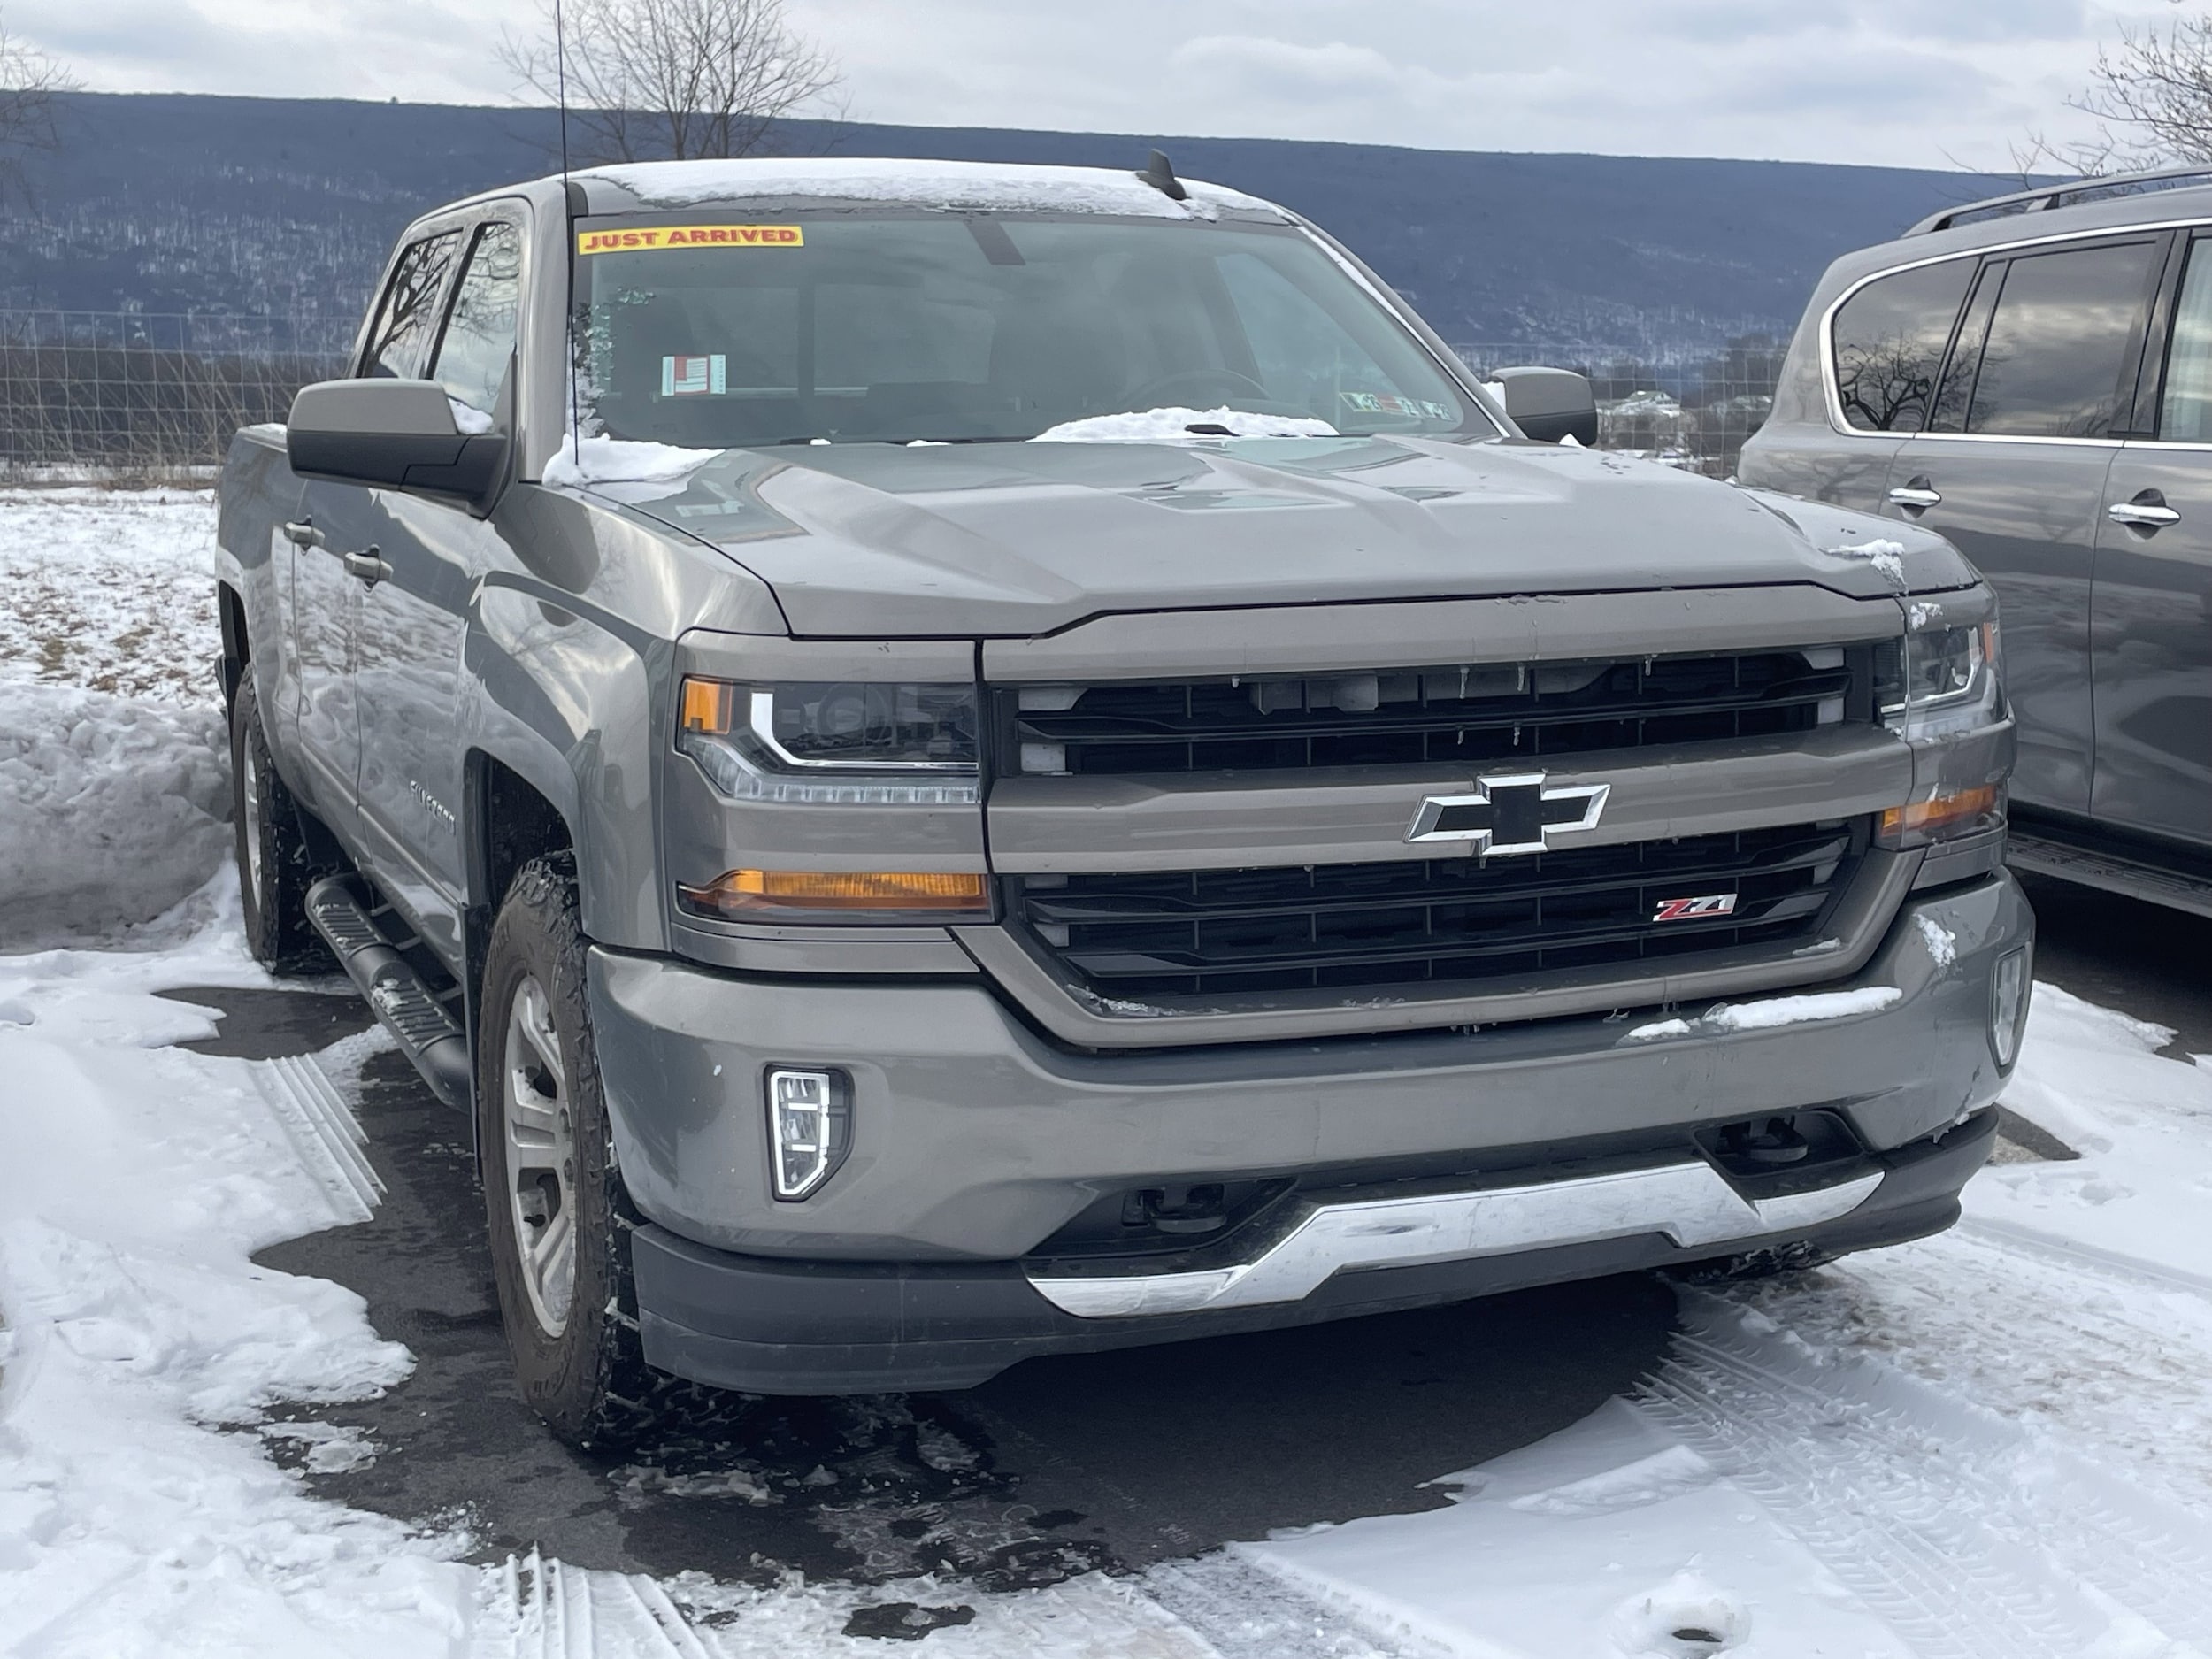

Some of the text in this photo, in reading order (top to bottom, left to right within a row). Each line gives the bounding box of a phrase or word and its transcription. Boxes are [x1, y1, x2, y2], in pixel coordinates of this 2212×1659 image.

[585, 229, 799, 250] JUST ARRIVED
[1653, 893, 1738, 922] Z71
